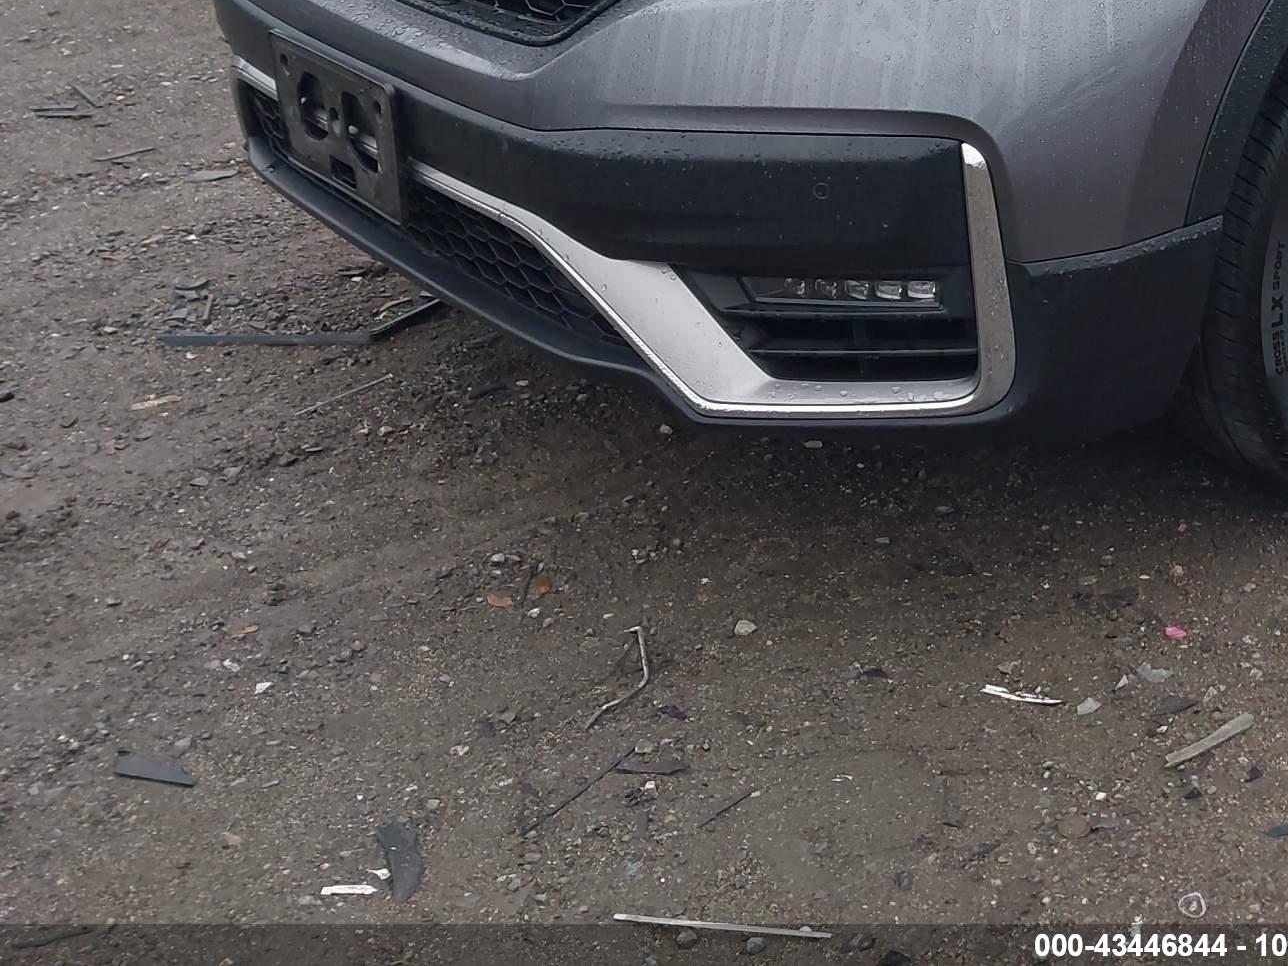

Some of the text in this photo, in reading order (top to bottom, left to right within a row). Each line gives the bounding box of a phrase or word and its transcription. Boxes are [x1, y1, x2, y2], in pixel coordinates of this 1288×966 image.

[1271, 240, 1286, 375] CROSS LX SPORT
